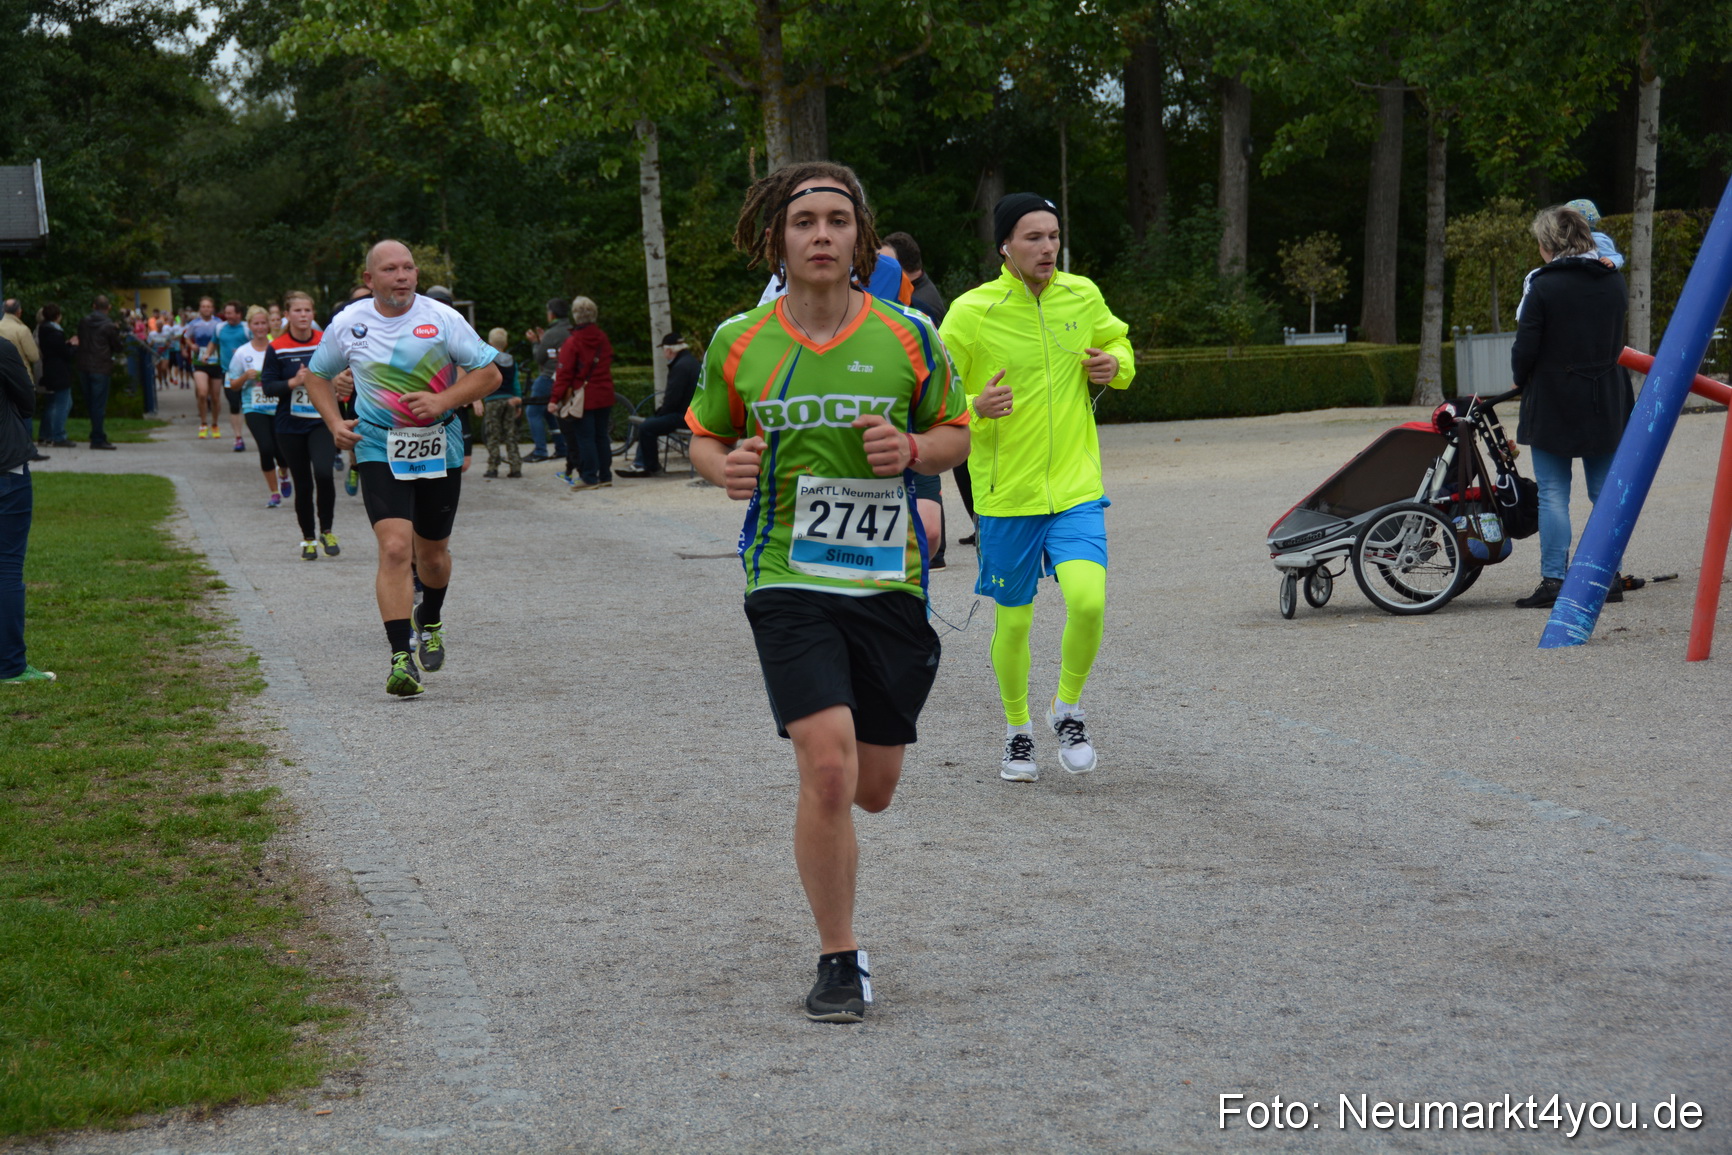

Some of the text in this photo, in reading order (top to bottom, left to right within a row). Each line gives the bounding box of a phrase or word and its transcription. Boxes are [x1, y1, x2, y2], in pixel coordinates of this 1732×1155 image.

[752, 394, 898, 431] BOCK
[412, 430, 437, 438] Neumarkt
[394, 437, 442, 459] 2256
[800, 486, 839, 496] PARTL
[841, 487, 895, 499] Neumarkt
[806, 500, 901, 541] 2747
[825, 548, 874, 567] Simon
